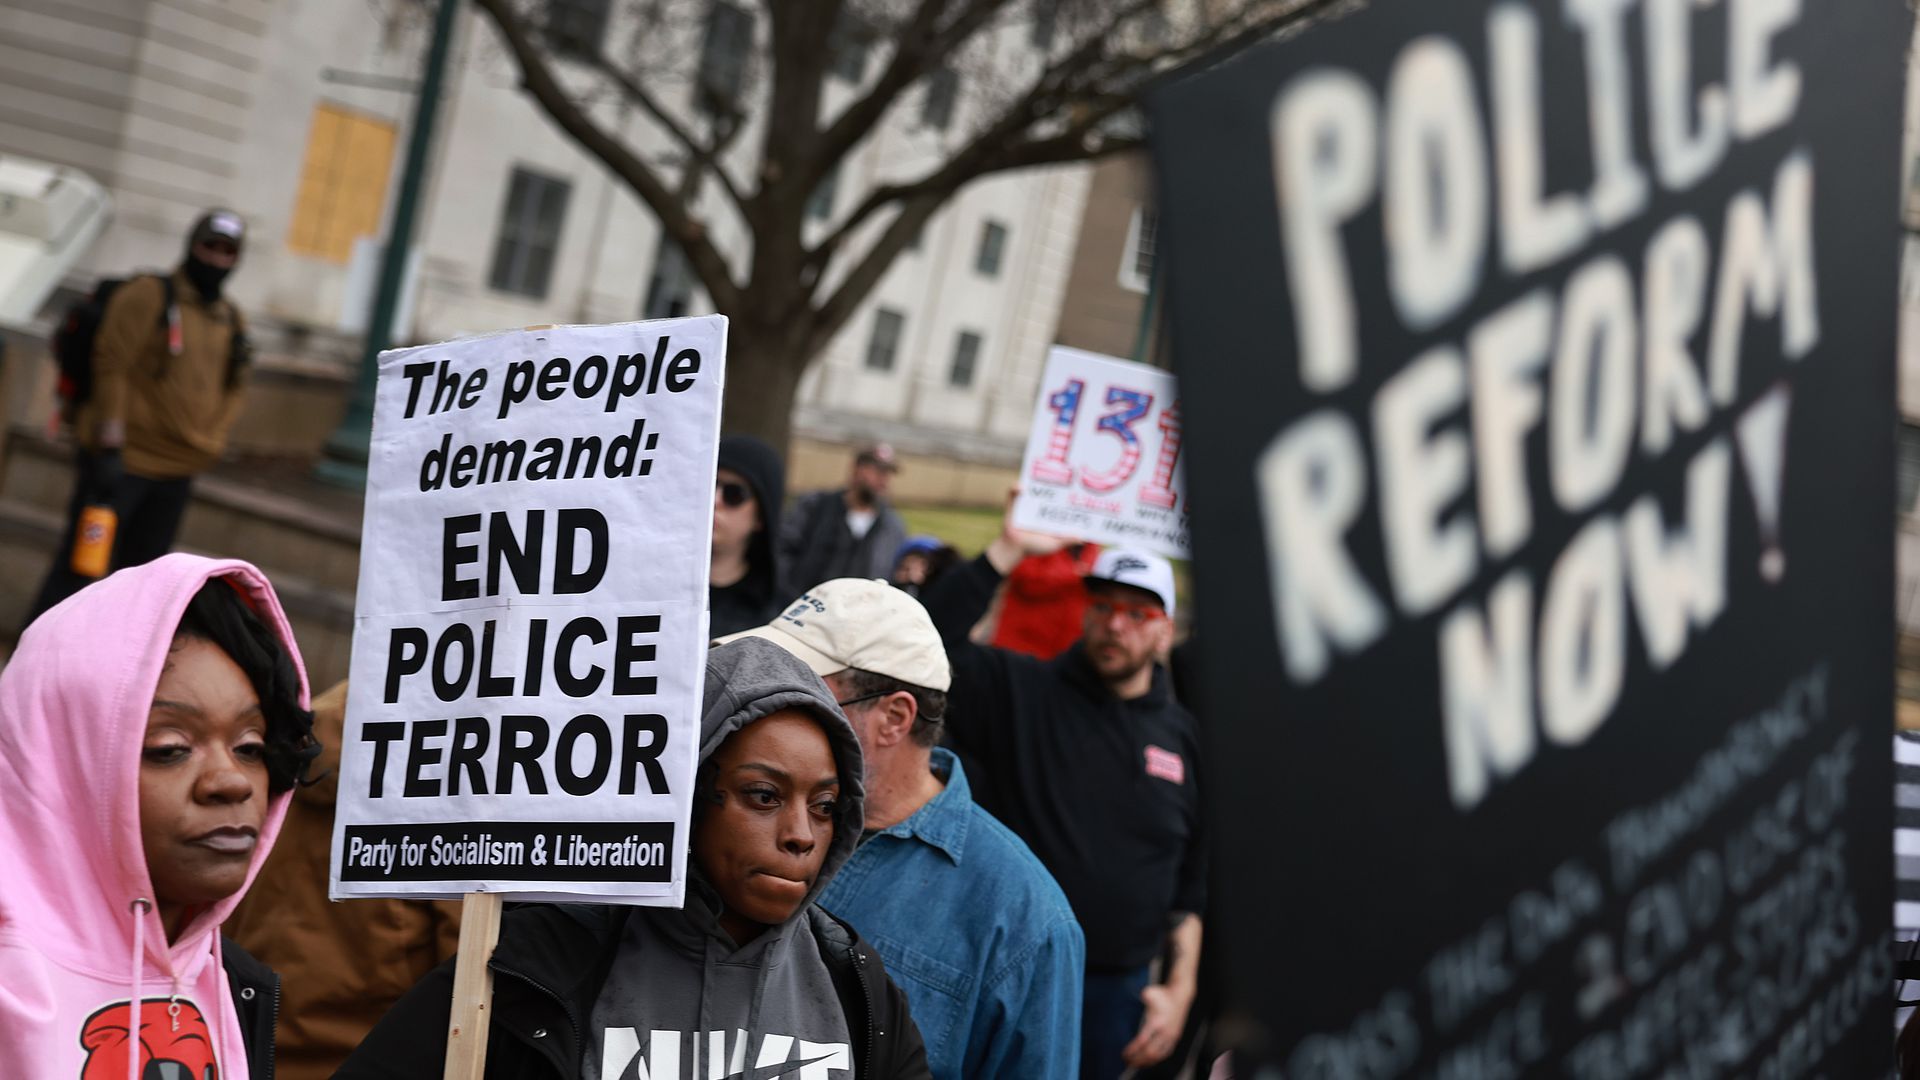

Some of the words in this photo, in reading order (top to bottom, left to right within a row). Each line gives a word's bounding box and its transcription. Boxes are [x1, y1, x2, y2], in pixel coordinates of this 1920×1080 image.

[1270, 0, 1802, 393] POLICE
[403, 359, 489, 419] The
[497, 335, 701, 419] people
[1256, 148, 1822, 686] REFORM
[420, 418, 660, 492] demand:
[442, 508, 610, 601] END
[1437, 380, 1792, 812] NOW!
[383, 615, 661, 704] POLICE
[361, 714, 671, 798] TERROR
[348, 836, 397, 874] Party
[400, 835, 428, 867] for
[430, 833, 524, 867] Socialism
[530, 837, 548, 865] &
[554, 834, 665, 867] Liberation
